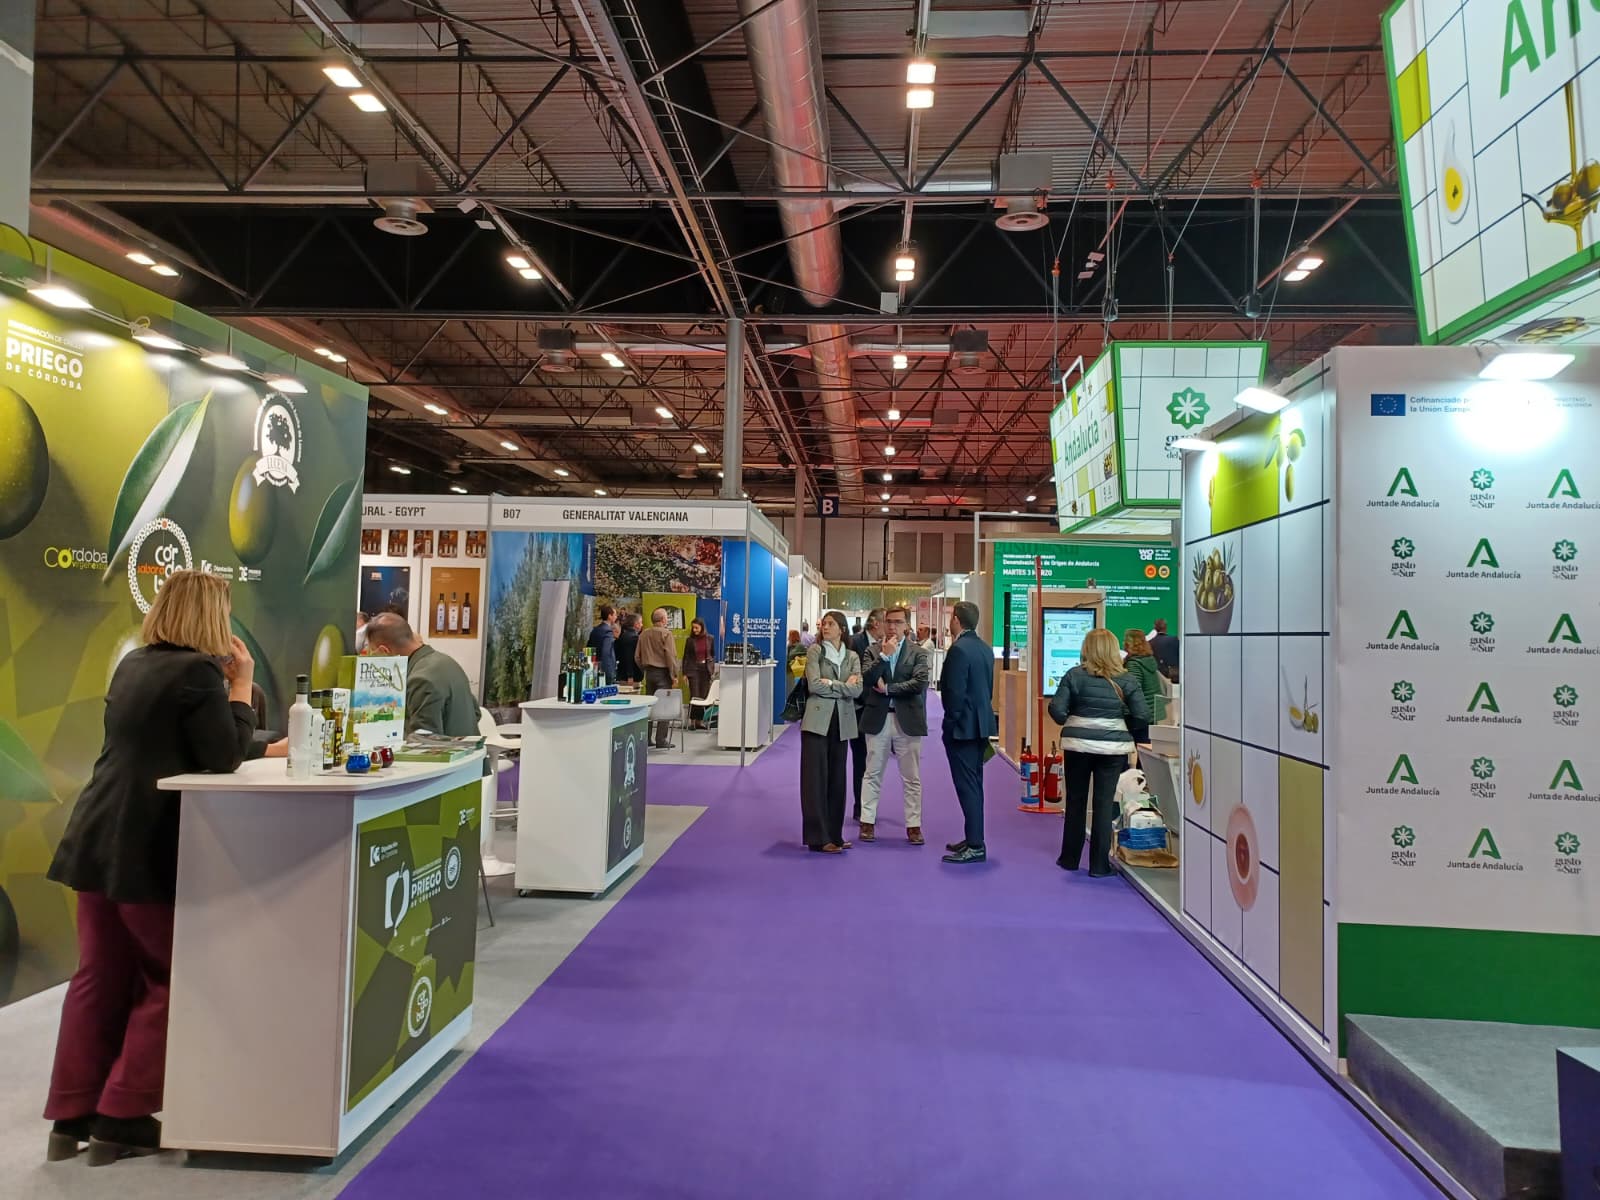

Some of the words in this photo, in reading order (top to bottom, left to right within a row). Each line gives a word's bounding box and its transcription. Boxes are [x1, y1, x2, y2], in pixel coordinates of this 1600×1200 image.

[1500, 0, 1600, 99] An
[6, 337, 83, 378] PRIEGO
[6, 362, 21, 373] DE
[822, 499, 834, 515] B
[1400, 499, 1440, 508] Andalucía
[395, 506, 426, 516] EGYPT
[503, 508, 521, 520] B07
[562, 509, 626, 522] GENERALITAT
[628, 510, 689, 523] VALENCIANA
[1480, 571, 1521, 579] Andalucía
[1400, 642, 1440, 651] Andalucía
[1481, 714, 1522, 724] Andalucía
[1400, 786, 1440, 795] Andalucía
[1482, 861, 1524, 871] Andalucía
[411, 869, 442, 899] PRIEGO
